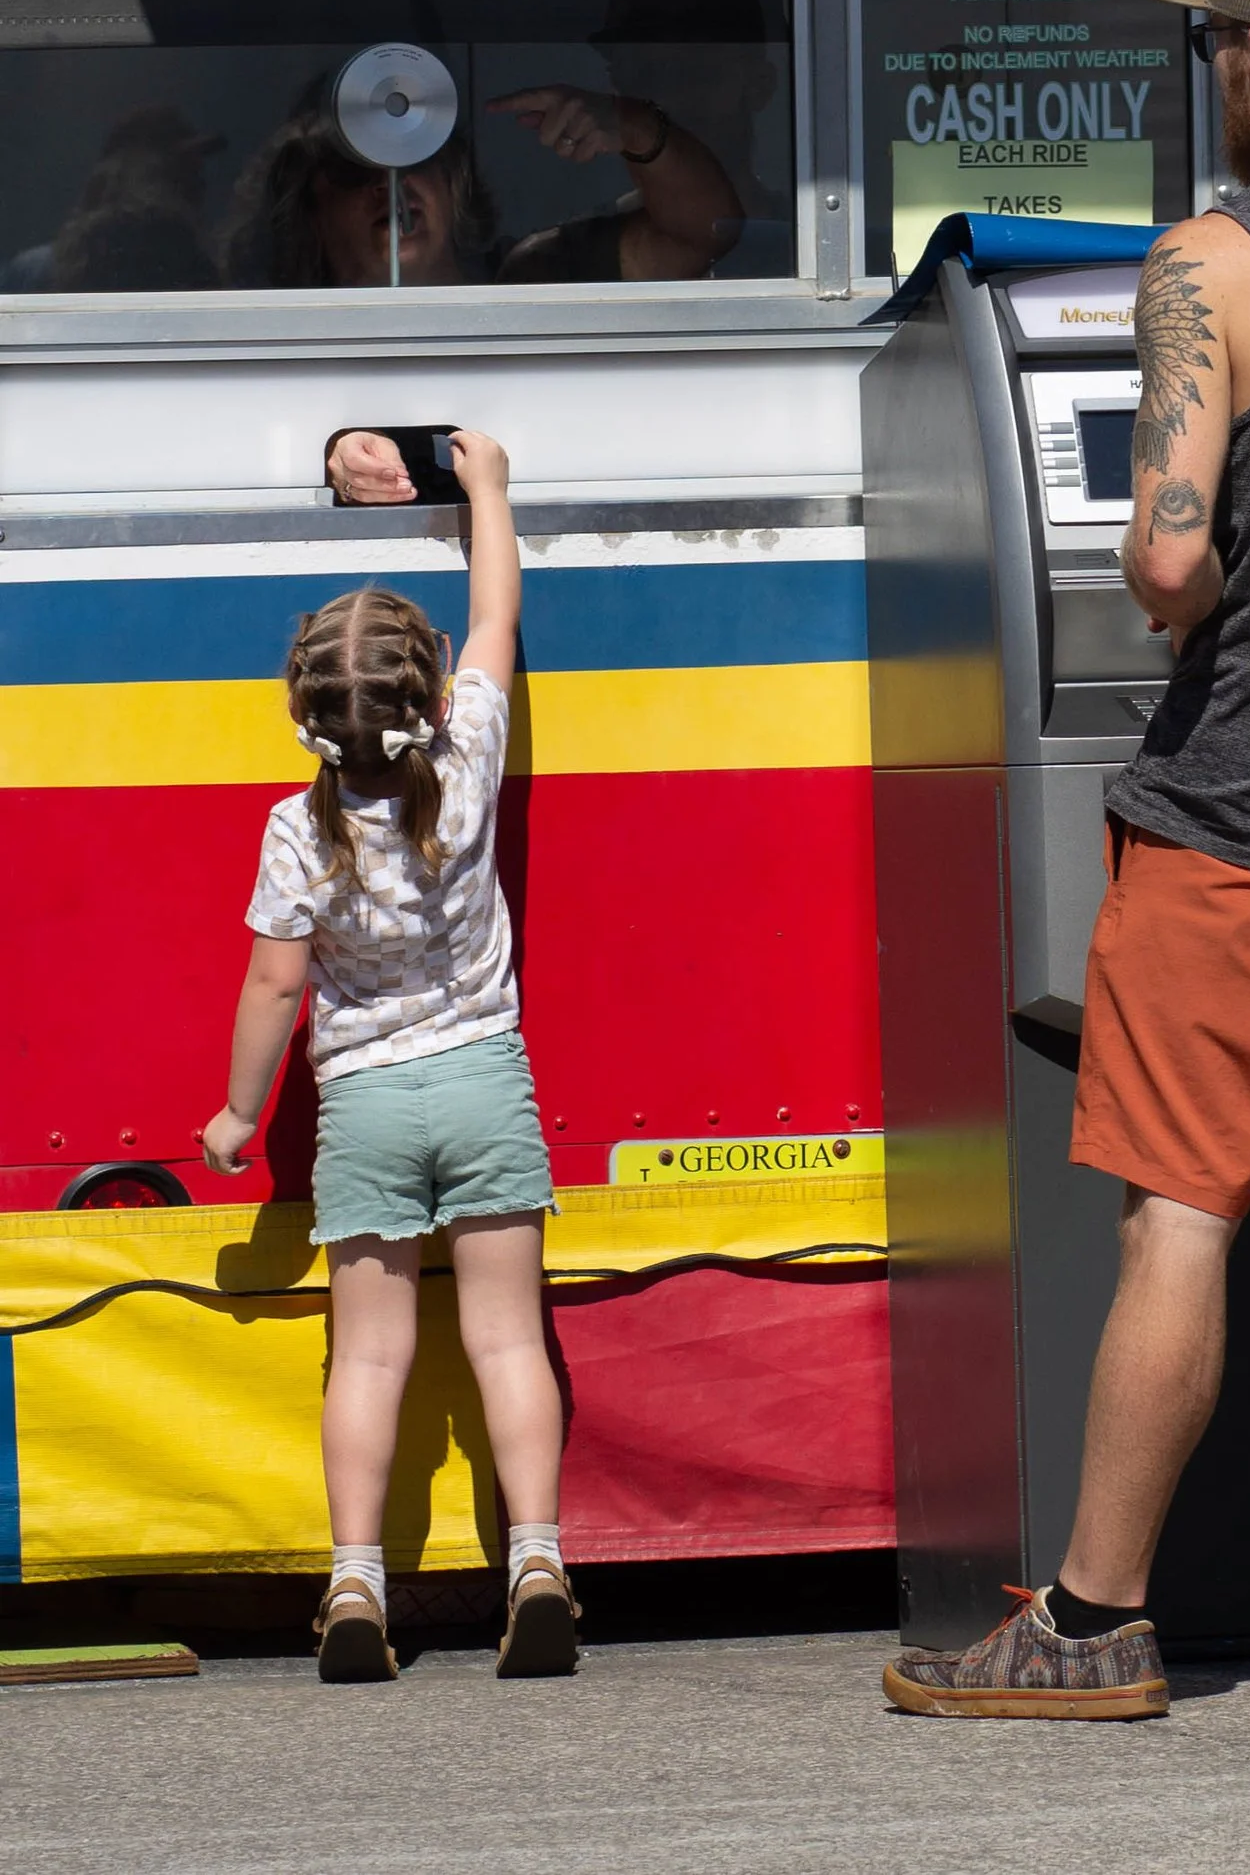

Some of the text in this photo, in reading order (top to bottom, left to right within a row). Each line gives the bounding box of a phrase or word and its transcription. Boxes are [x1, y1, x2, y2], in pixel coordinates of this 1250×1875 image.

[964, 25, 1090, 44] NO REFUNDS
[884, 49, 1170, 71] DUE TO INCLEMENT WEATHER
[906, 80, 1151, 145] CASH ONLY
[958, 143, 1088, 164] EACH RIDE
[984, 194, 1062, 215] TAKES
[680, 1142, 834, 1173] GEORGIA
